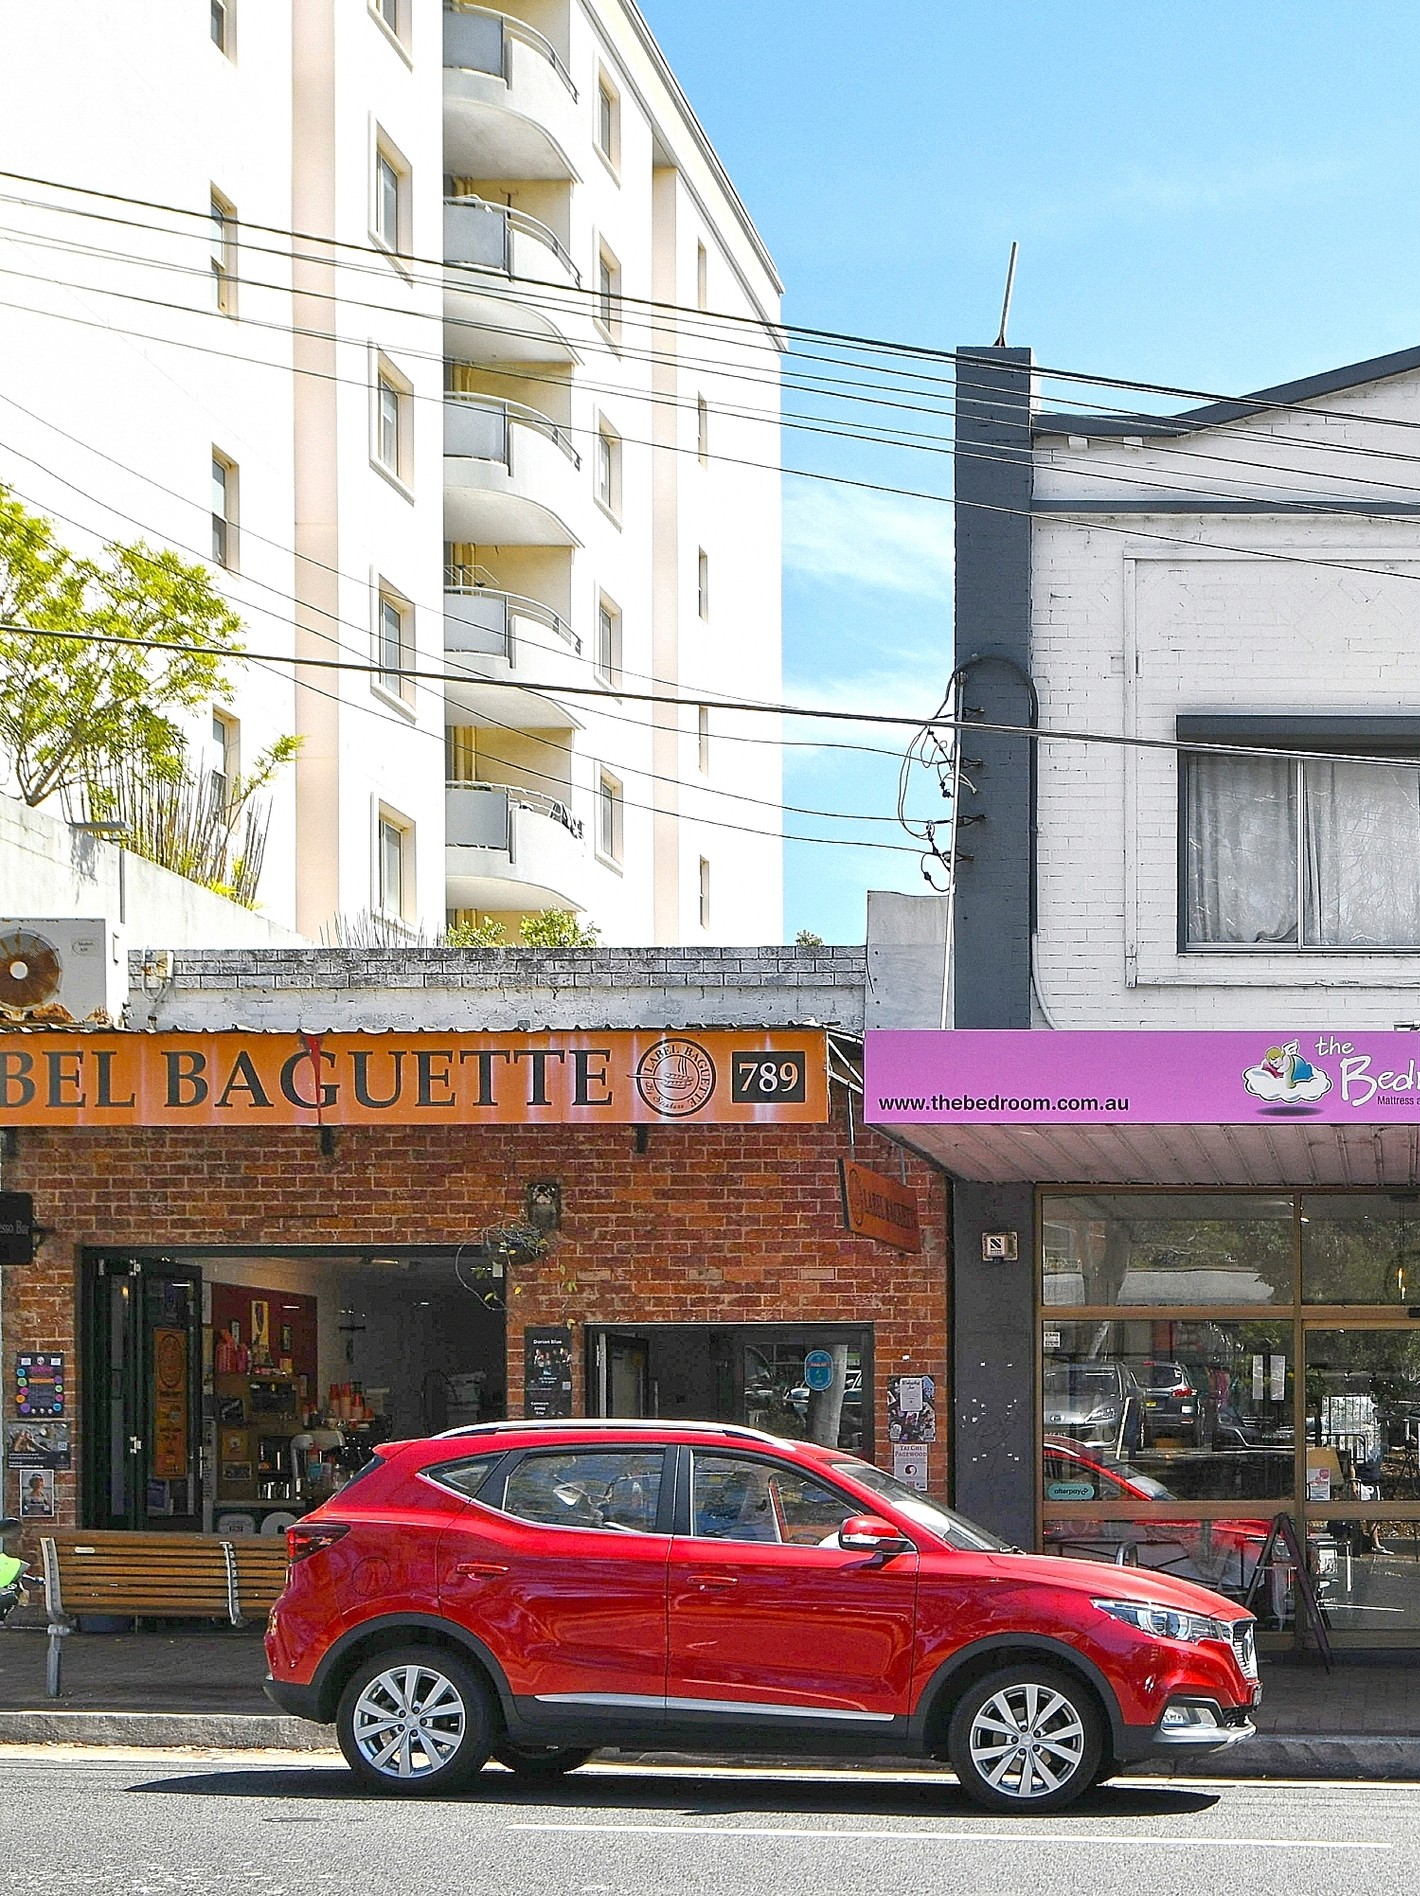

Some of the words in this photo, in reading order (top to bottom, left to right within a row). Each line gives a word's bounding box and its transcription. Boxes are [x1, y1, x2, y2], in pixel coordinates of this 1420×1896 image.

[1315, 1035, 1354, 1056] the
[160, 1050, 613, 1109] BAGUETTE
[643, 1044, 680, 1073] LABEL
[683, 1046, 711, 1108] BAGUETTE
[738, 1062, 798, 1093] 789
[878, 1094, 1130, 1111] www.thebedroom.com.au
[1377, 1095, 1415, 1106] Mattress
